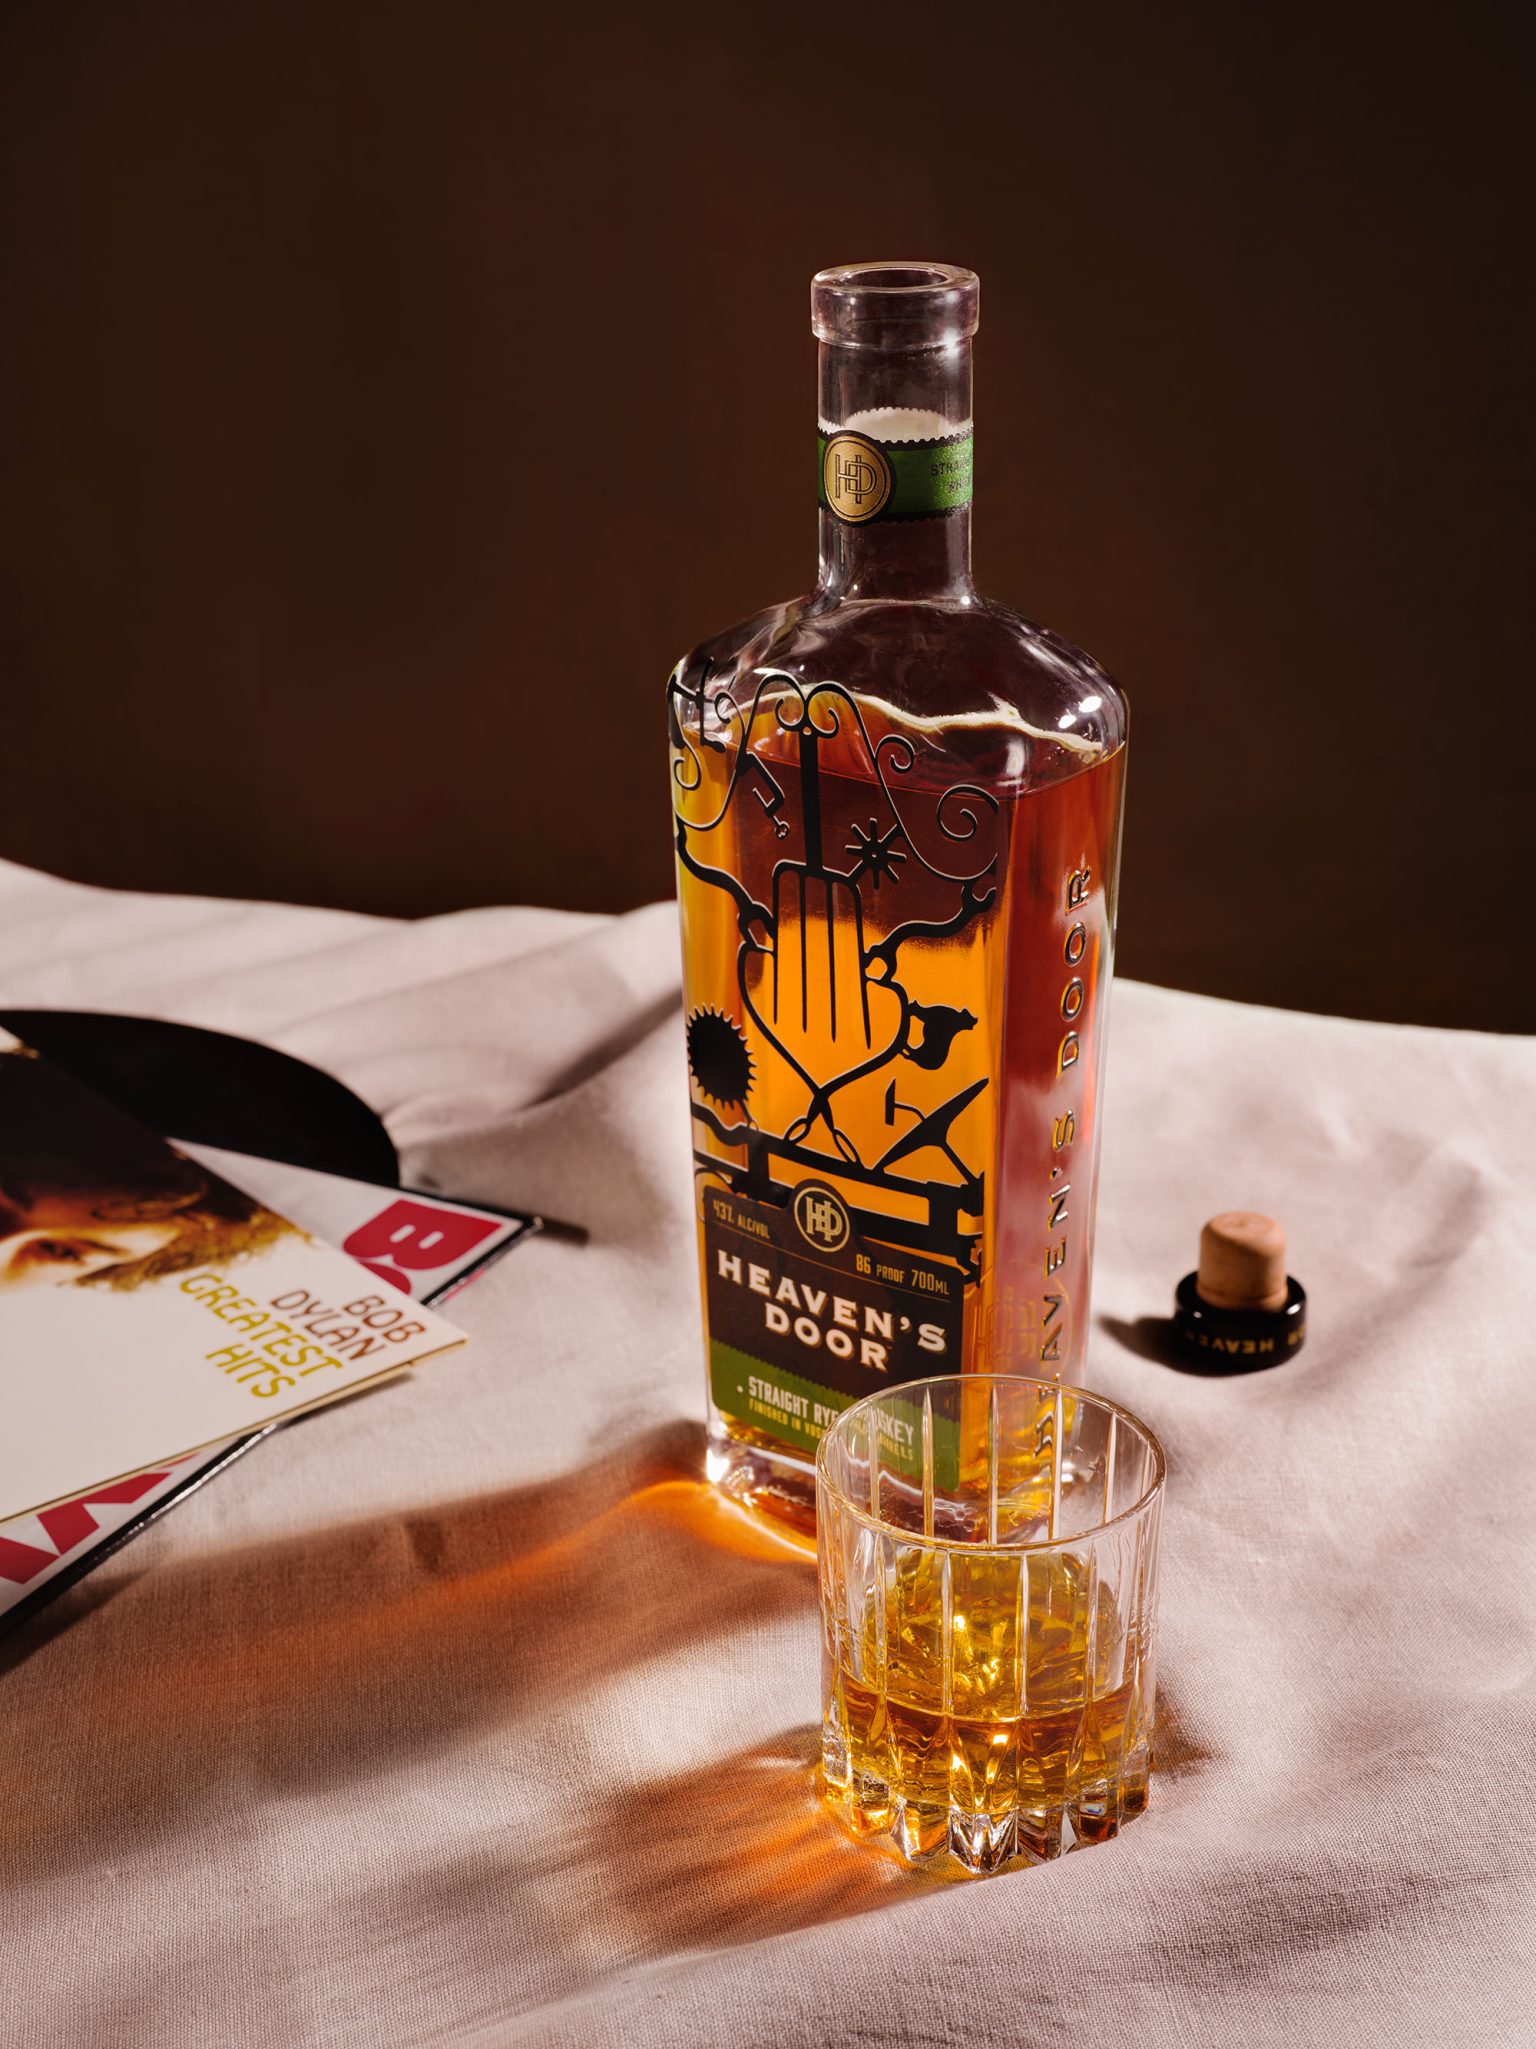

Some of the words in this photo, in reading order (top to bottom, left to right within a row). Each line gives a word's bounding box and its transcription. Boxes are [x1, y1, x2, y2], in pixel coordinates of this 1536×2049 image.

[1056, 865, 1091, 1078] DOOR
[737, 1213, 770, 1239] ALC/VOL
[717, 1249, 947, 1353] HEAVEN'S
[855, 1253, 871, 1275] 86
[876, 1264, 905, 1284] PROOF
[911, 1269, 950, 1296] 700ML
[180, 1272, 343, 1377] GREATEST
[270, 1289, 386, 1361] DYLAN
[343, 1295, 426, 1343] BOB
[765, 1301, 888, 1373] DOOR
[205, 1343, 296, 1398] HITS
[748, 1375, 809, 1419] STRAIGHT
[749, 1398, 789, 1426] FINISHED
[791, 1416, 801, 1430] IN
